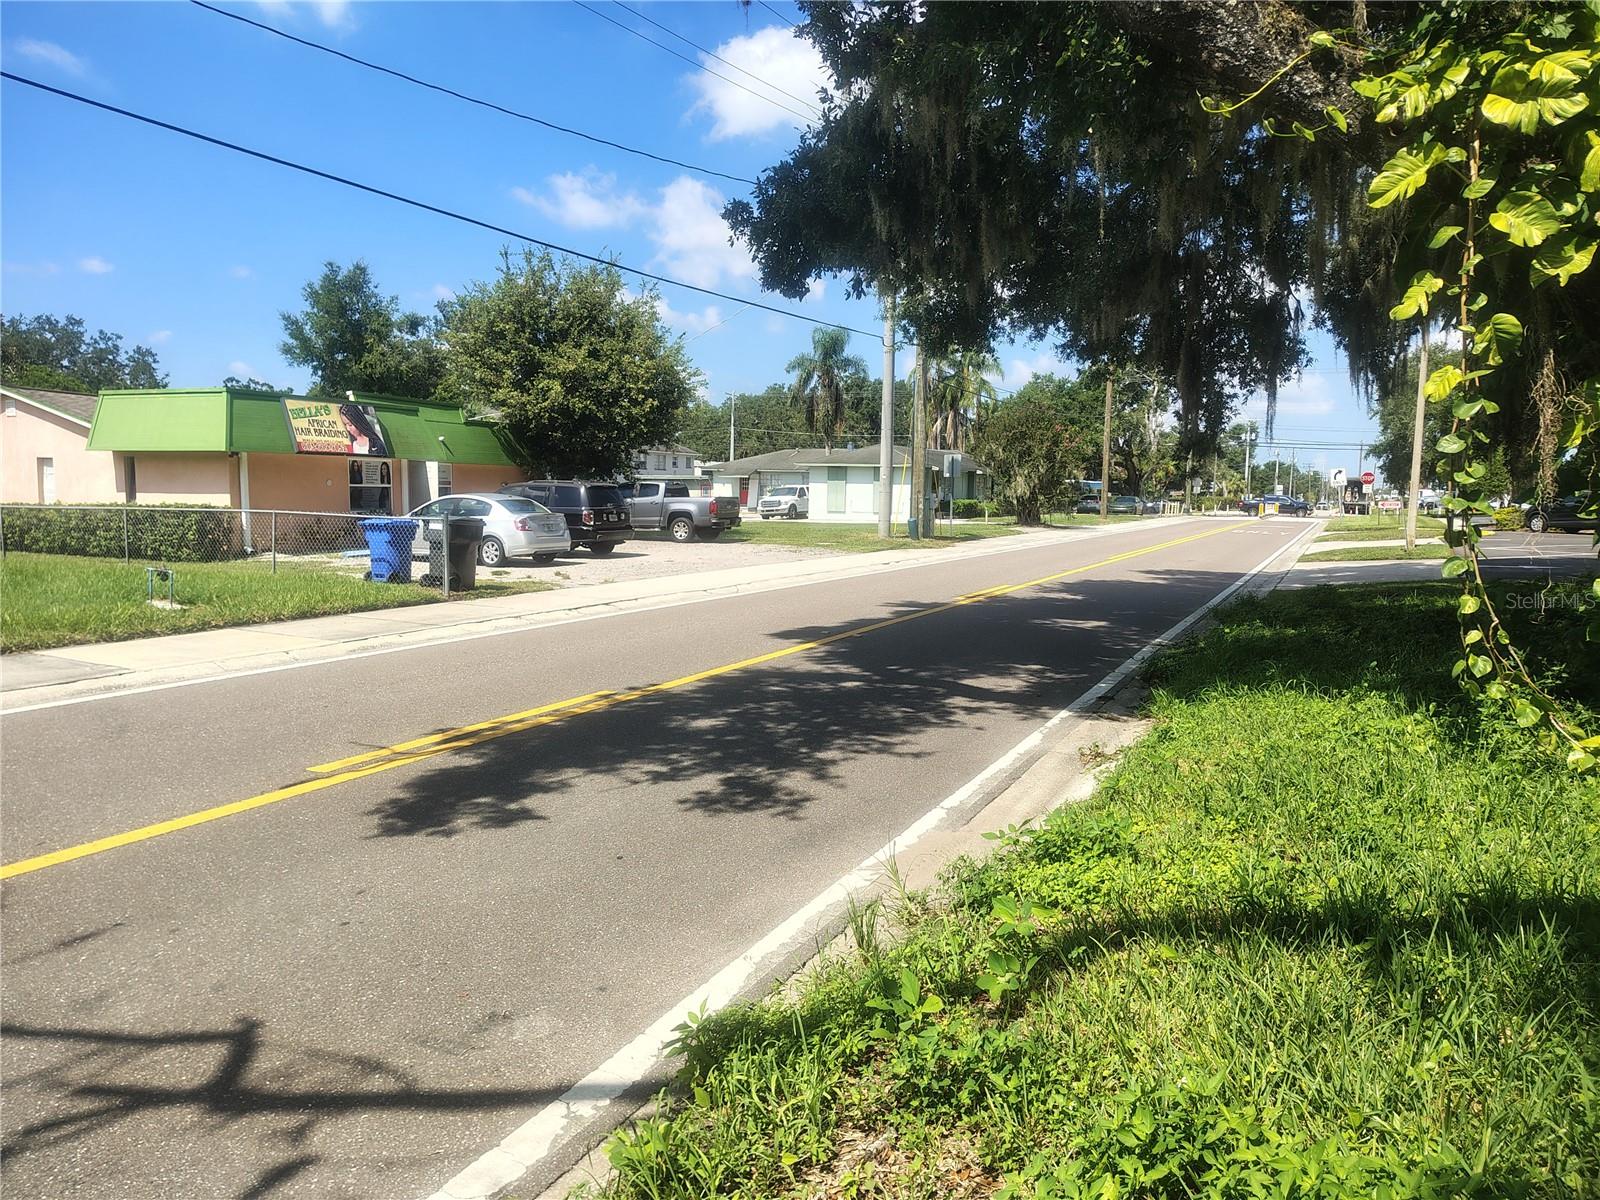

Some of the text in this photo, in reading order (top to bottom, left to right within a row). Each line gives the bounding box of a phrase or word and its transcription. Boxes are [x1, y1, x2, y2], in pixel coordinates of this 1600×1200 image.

[307, 419, 337, 428] AFRICAN
[294, 427, 349, 439] HAIR BRAIDING
